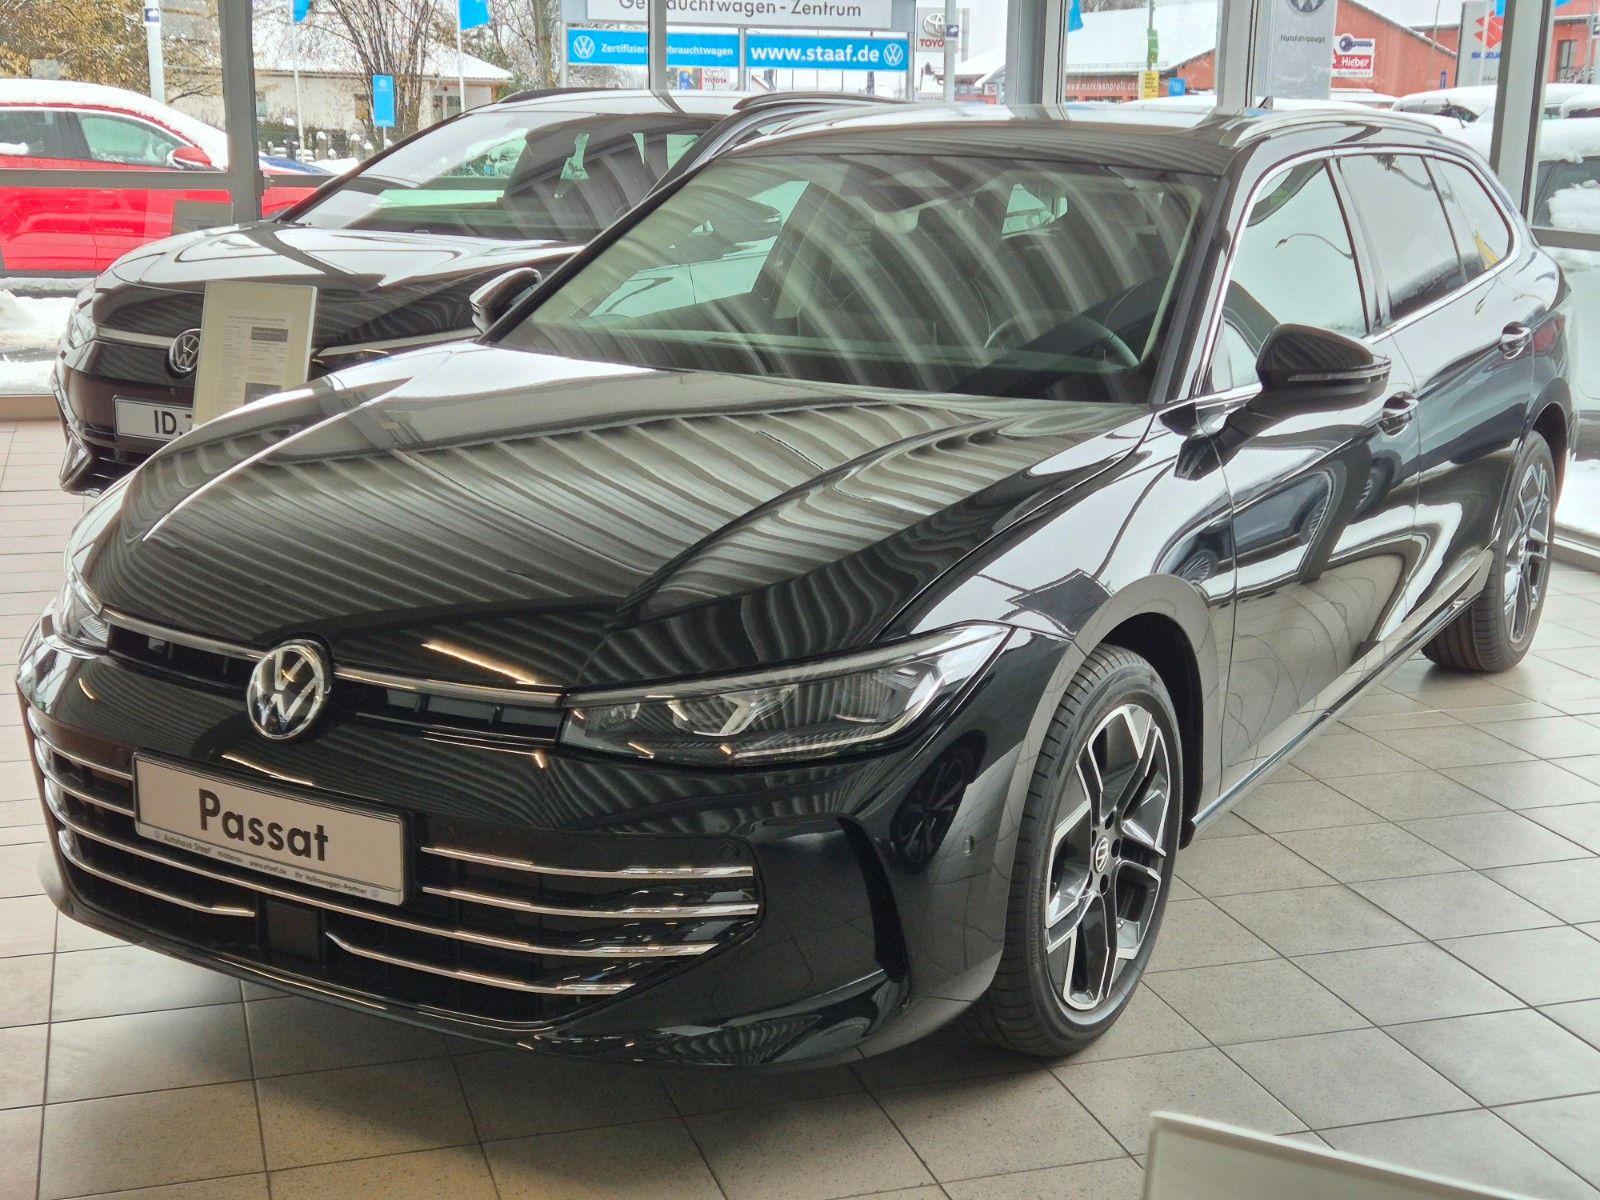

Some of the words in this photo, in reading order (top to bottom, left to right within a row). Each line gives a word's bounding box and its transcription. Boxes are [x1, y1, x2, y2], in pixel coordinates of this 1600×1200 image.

[619, 0, 776, 16] Geauchtwagen
[791, 0, 861, 16] Zentrum
[920, 39, 944, 47] TOYO
[666, 46, 733, 57] brauchtwagen
[751, 45, 879, 62] www.staaf.de
[1342, 57, 1369, 66] Hieber
[199, 788, 329, 861] Passat
